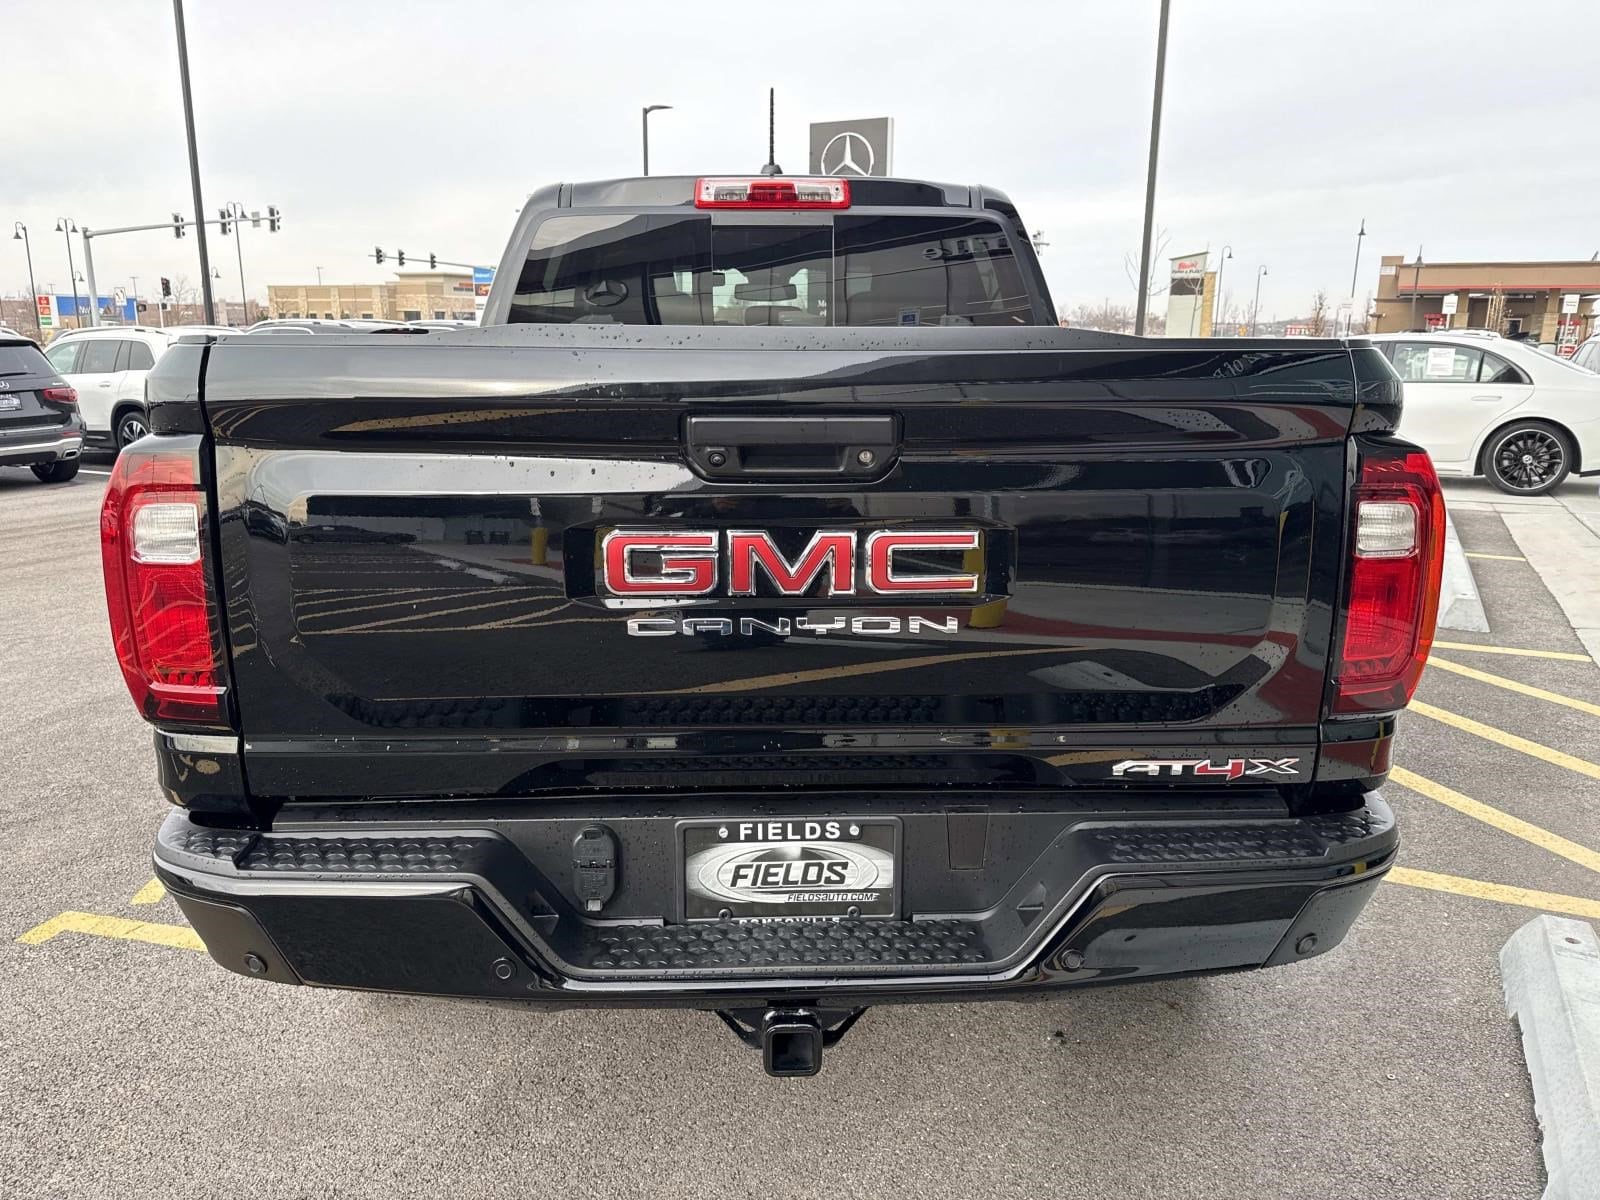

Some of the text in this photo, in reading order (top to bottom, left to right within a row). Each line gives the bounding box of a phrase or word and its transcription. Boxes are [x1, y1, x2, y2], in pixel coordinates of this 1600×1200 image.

[602, 529, 981, 597] GMC
[626, 614, 959, 637] CANYON
[1111, 757, 1301, 781] AT4X
[738, 821, 842, 841] FIELDS
[729, 860, 849, 888] FIELDS
